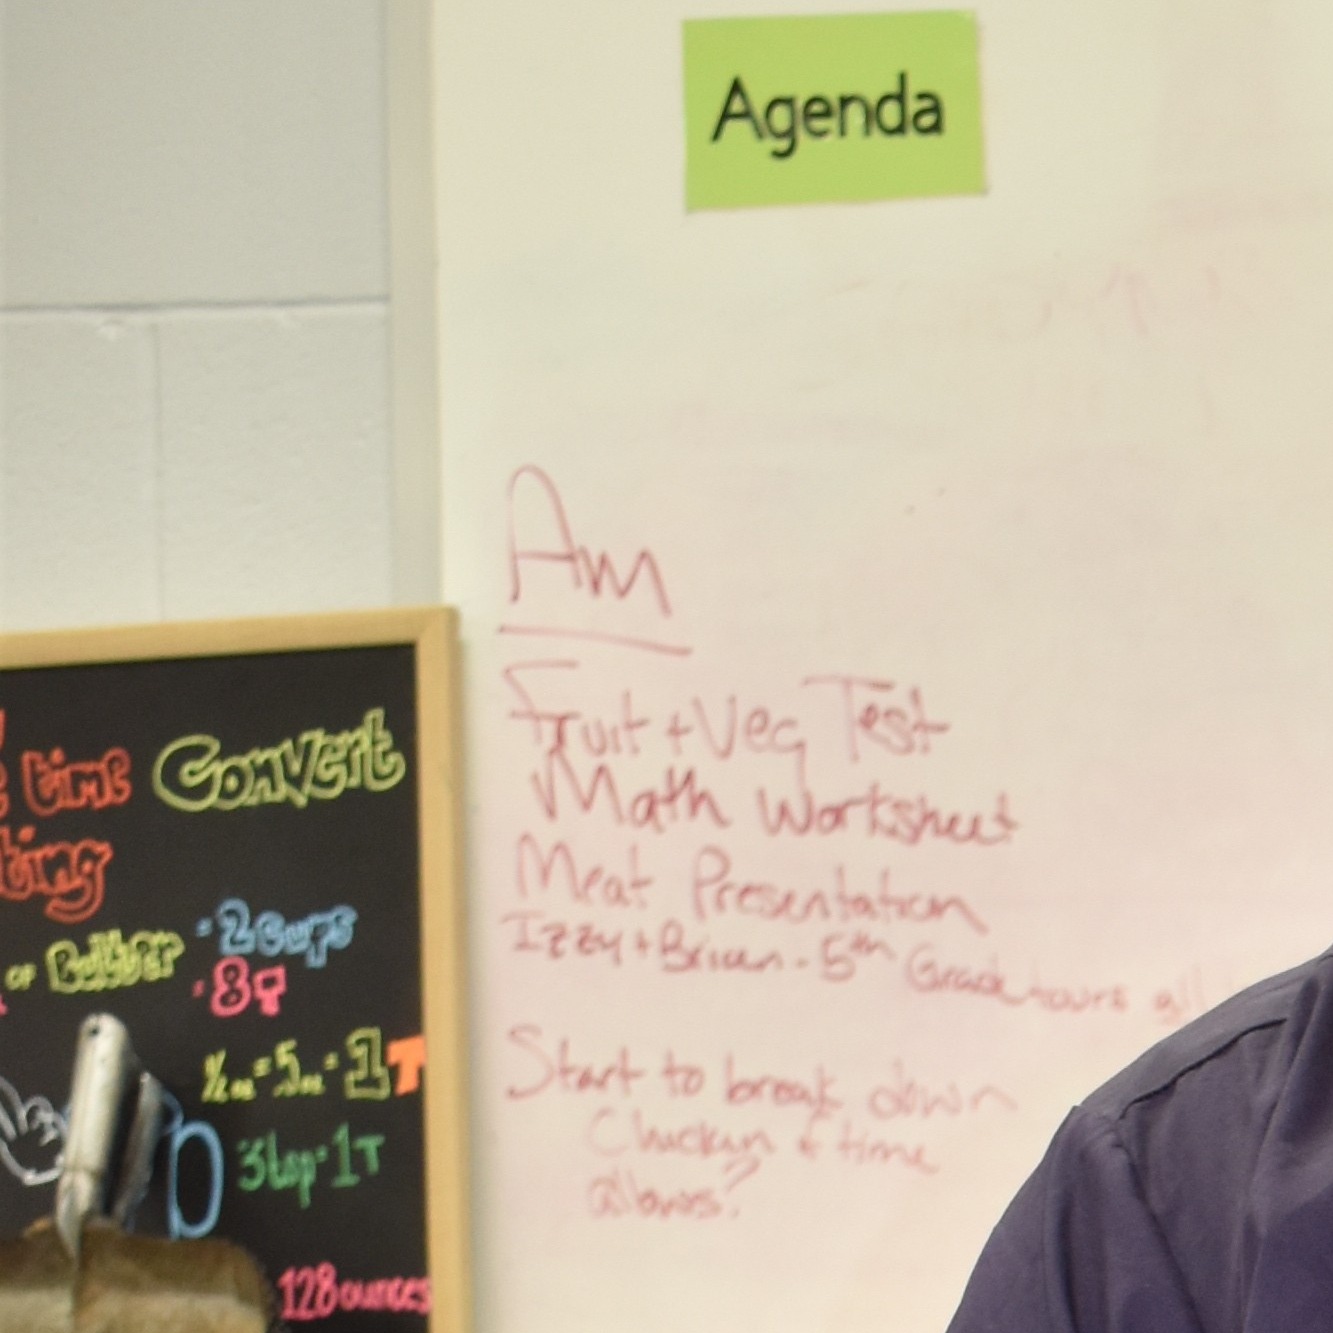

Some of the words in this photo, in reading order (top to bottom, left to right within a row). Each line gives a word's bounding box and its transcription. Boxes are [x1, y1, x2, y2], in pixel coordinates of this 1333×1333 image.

[711, 70, 944, 160] Agenda
[151, 706, 406, 813] Convert
[800, 674, 952, 764] Test
[530, 747, 732, 834] Math
[516, 832, 654, 910] Meat
[506, 1023, 645, 1100] Start
[660, 1048, 705, 1096] to
